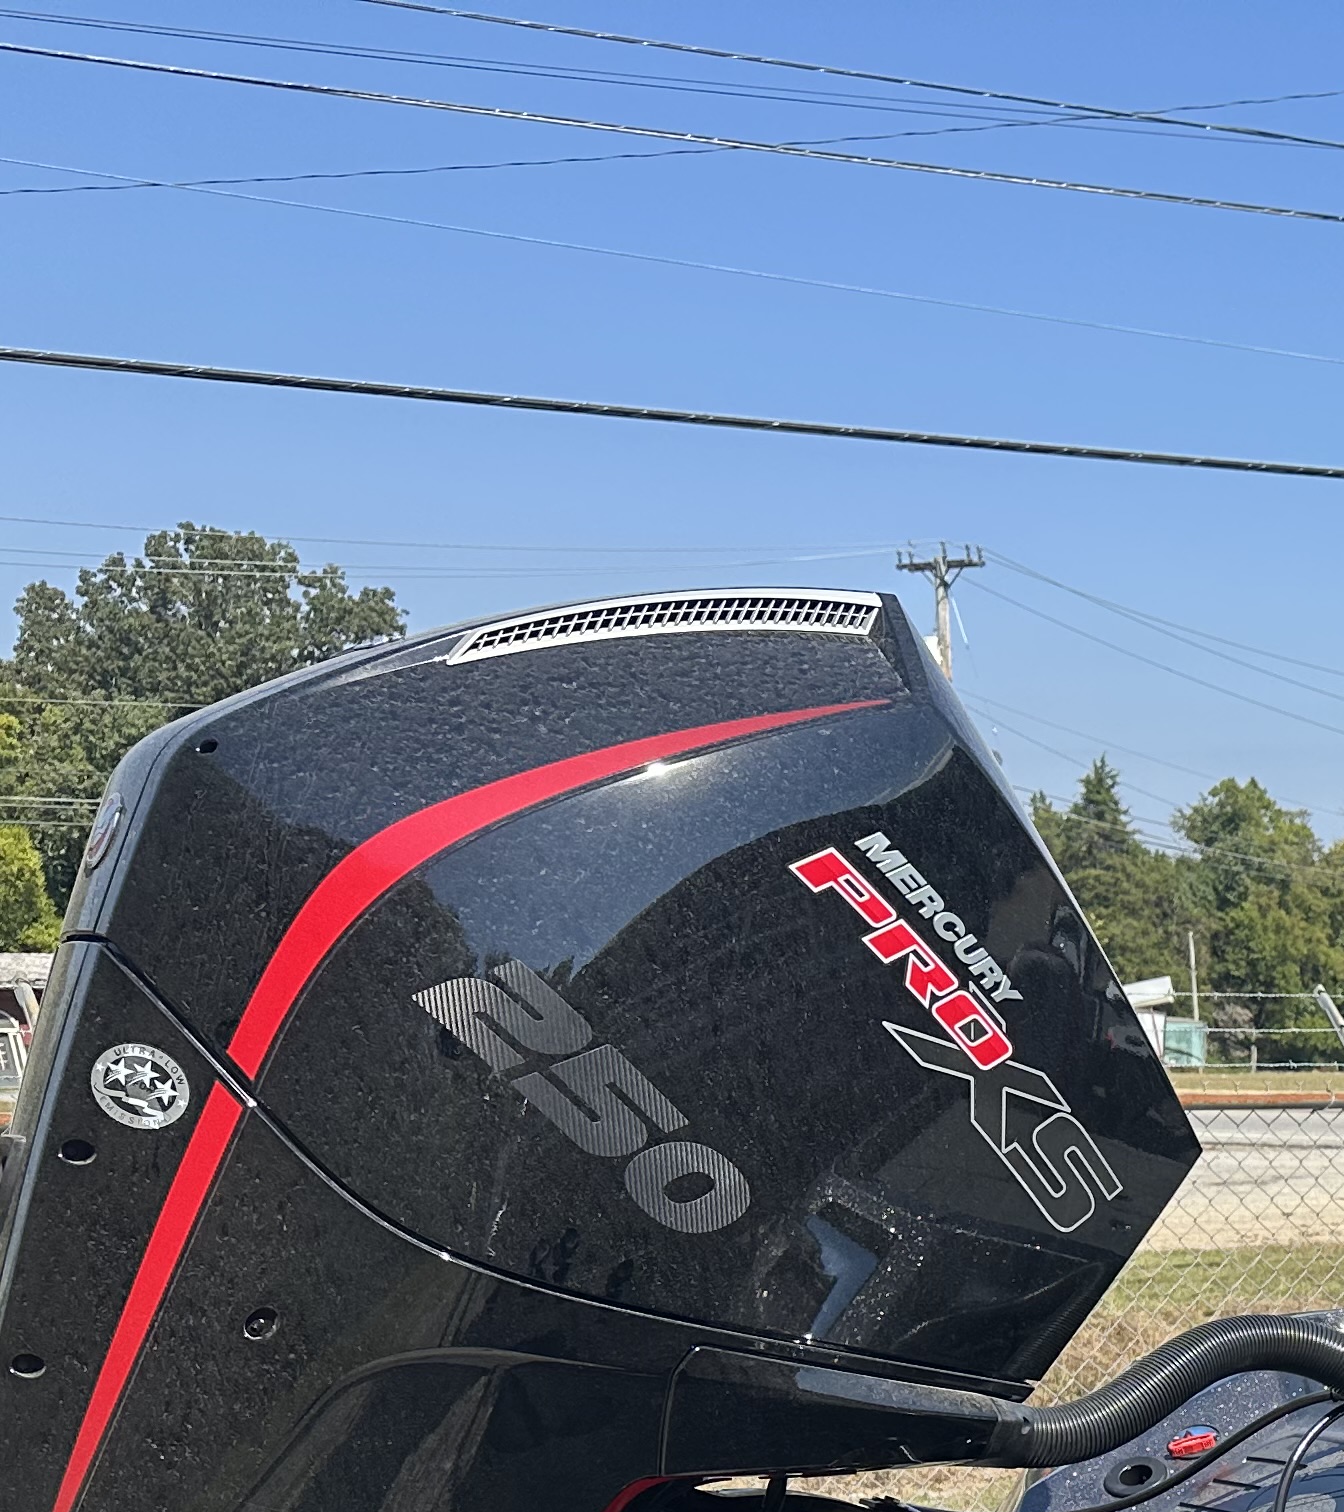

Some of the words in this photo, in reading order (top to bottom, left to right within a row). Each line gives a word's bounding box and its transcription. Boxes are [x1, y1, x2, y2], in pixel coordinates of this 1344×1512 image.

[788, 847, 1013, 1071] PRO
[854, 831, 1024, 1002] MERCURY
[113, 1045, 156, 1058] ULTRA
[164, 1059, 185, 1085] LOW
[411, 958, 751, 1233] 250
[881, 980, 1124, 1232] XS
